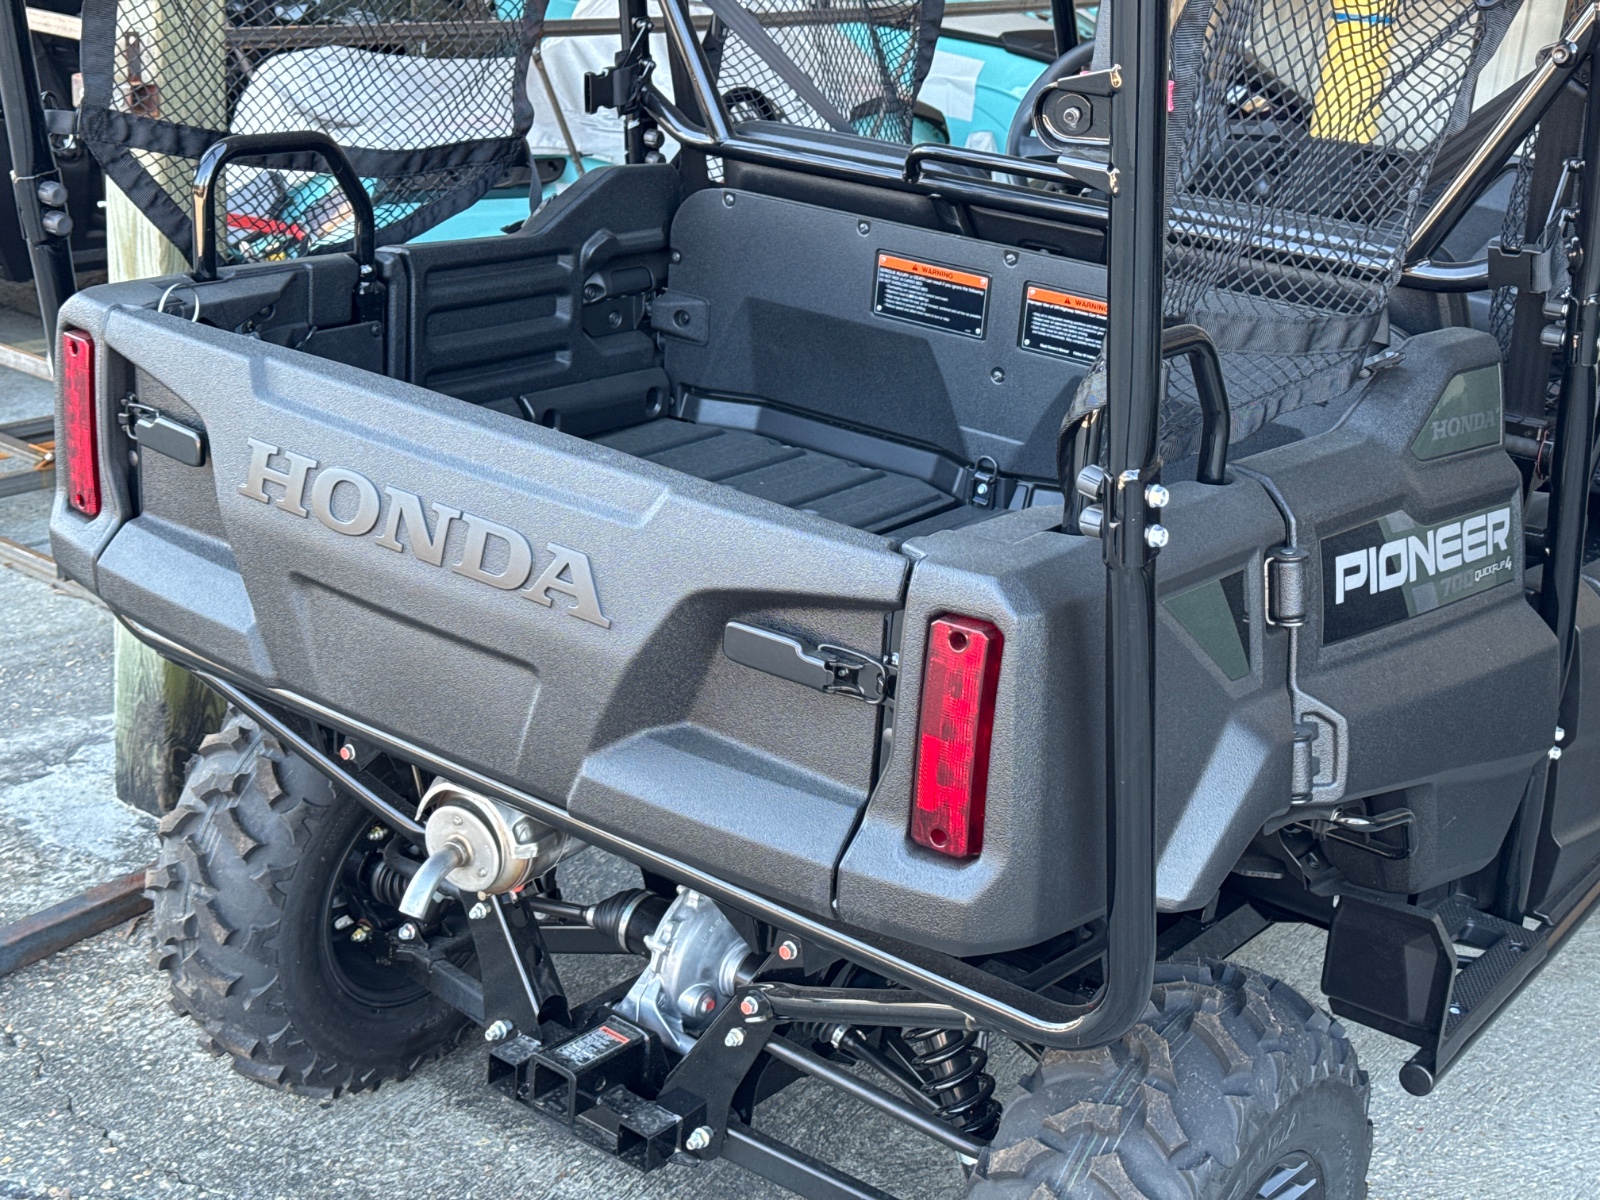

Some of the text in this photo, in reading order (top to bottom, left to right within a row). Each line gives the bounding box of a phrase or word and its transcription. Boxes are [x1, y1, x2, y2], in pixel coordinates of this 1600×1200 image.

[921, 266, 953, 279] WARNING
[1432, 410, 1496, 440] HONDA
[236, 436, 611, 629] HONDA
[1335, 507, 1511, 605] PIONEER
[1440, 568, 1474, 597] 700
